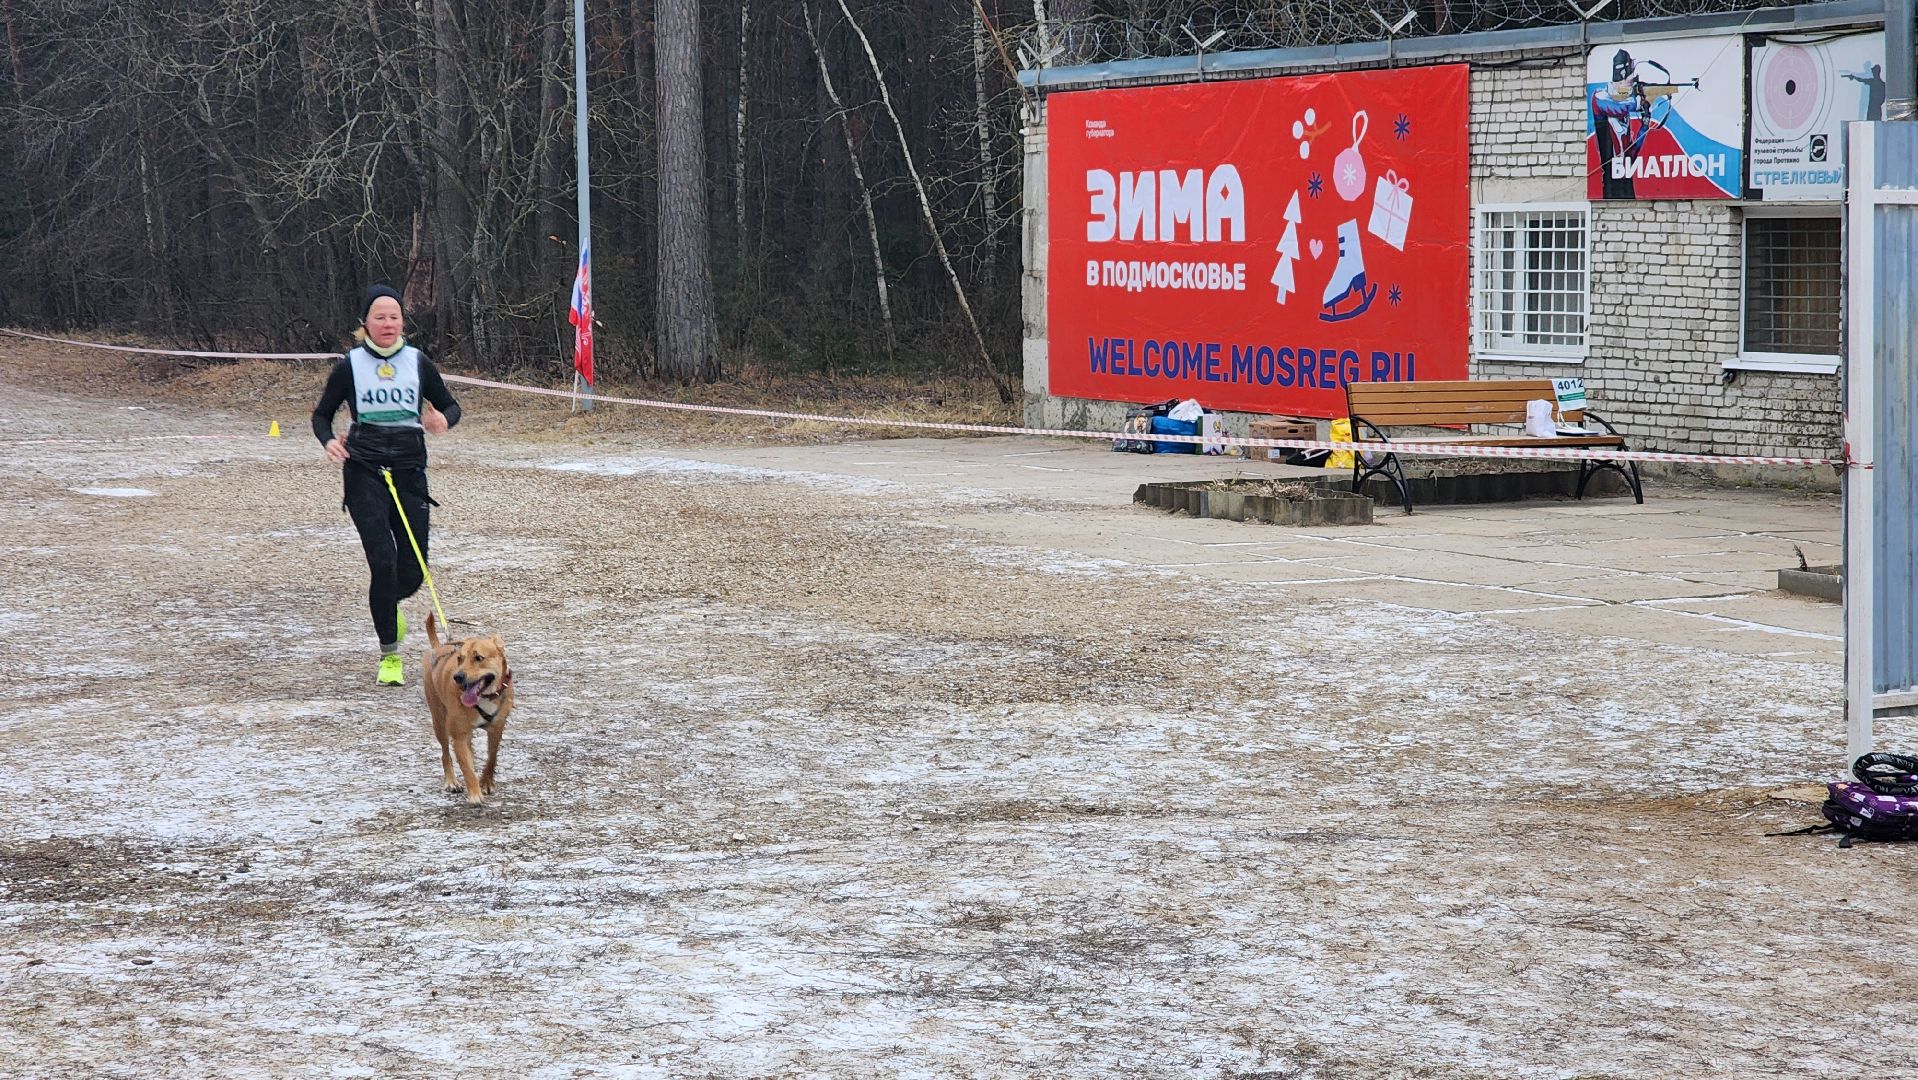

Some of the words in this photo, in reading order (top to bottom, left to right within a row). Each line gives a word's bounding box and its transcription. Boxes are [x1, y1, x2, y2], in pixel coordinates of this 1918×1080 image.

[1611, 153, 1726, 179] БИАТЛОН
[1086, 163, 1246, 242] ЗИМА
[1086, 260, 1100, 286] В
[1102, 260, 1246, 292] ПОДМОСКОВЬЕ
[1088, 336, 1416, 390] WELCOME.MOSREGRU
[361, 387, 415, 405] 4003
[1557, 378, 1584, 391] 4012
